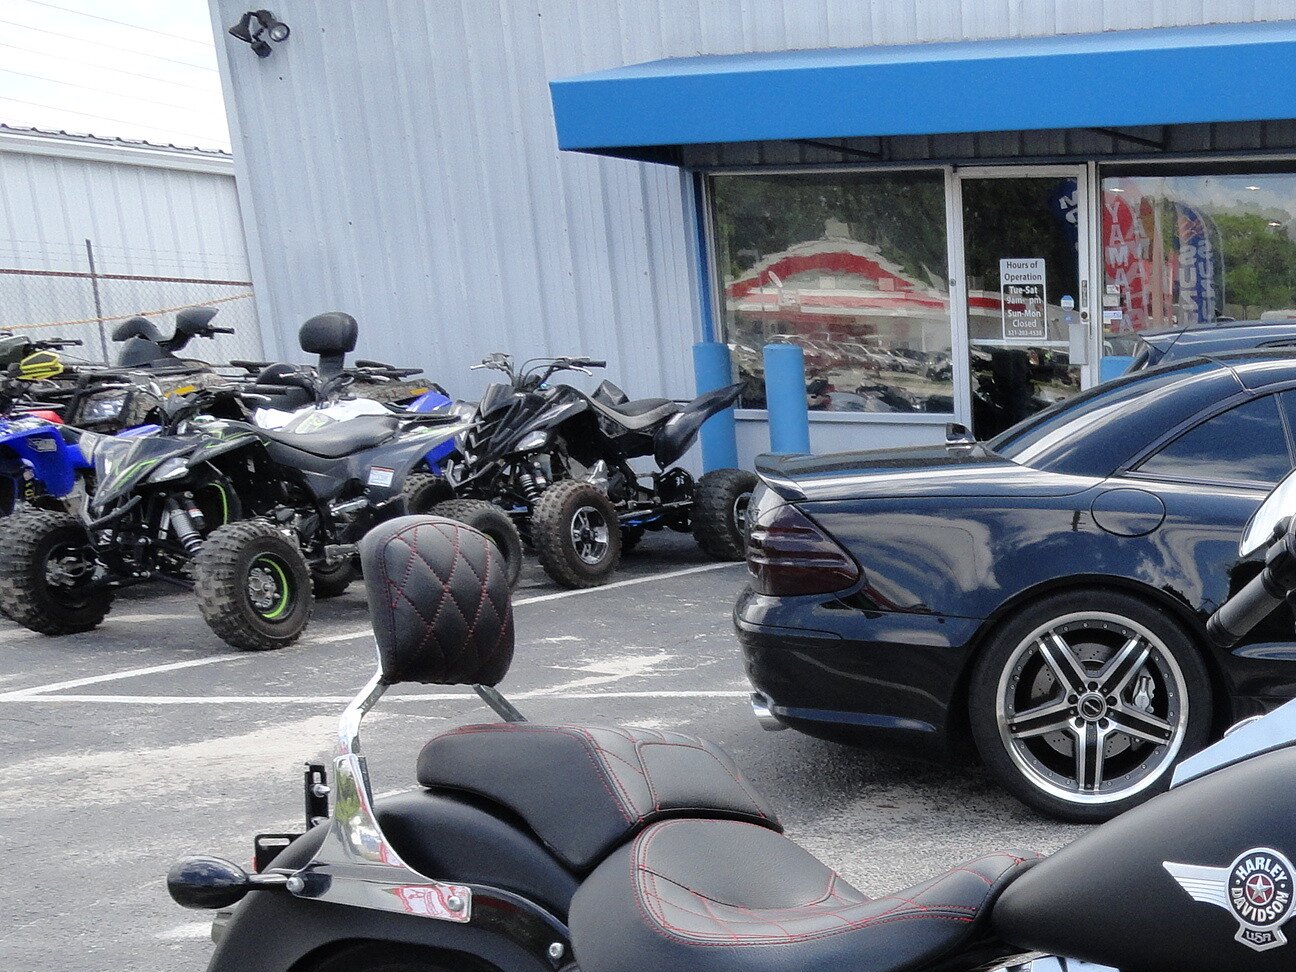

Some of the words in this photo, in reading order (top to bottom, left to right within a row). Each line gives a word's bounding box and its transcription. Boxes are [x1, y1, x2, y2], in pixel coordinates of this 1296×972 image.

[1006, 261, 1029, 269] Hours
[1030, 261, 1038, 269] of
[1004, 273, 1042, 282] Operation
[1008, 285, 1038, 294] Tue-Sat
[1008, 309, 1042, 318] Sun-Mon
[1012, 319, 1037, 328] Closed
[1235, 856, 1287, 883] HARLEY
[1231, 886, 1290, 923] DAVIDSON
[1245, 930, 1272, 944] USA
